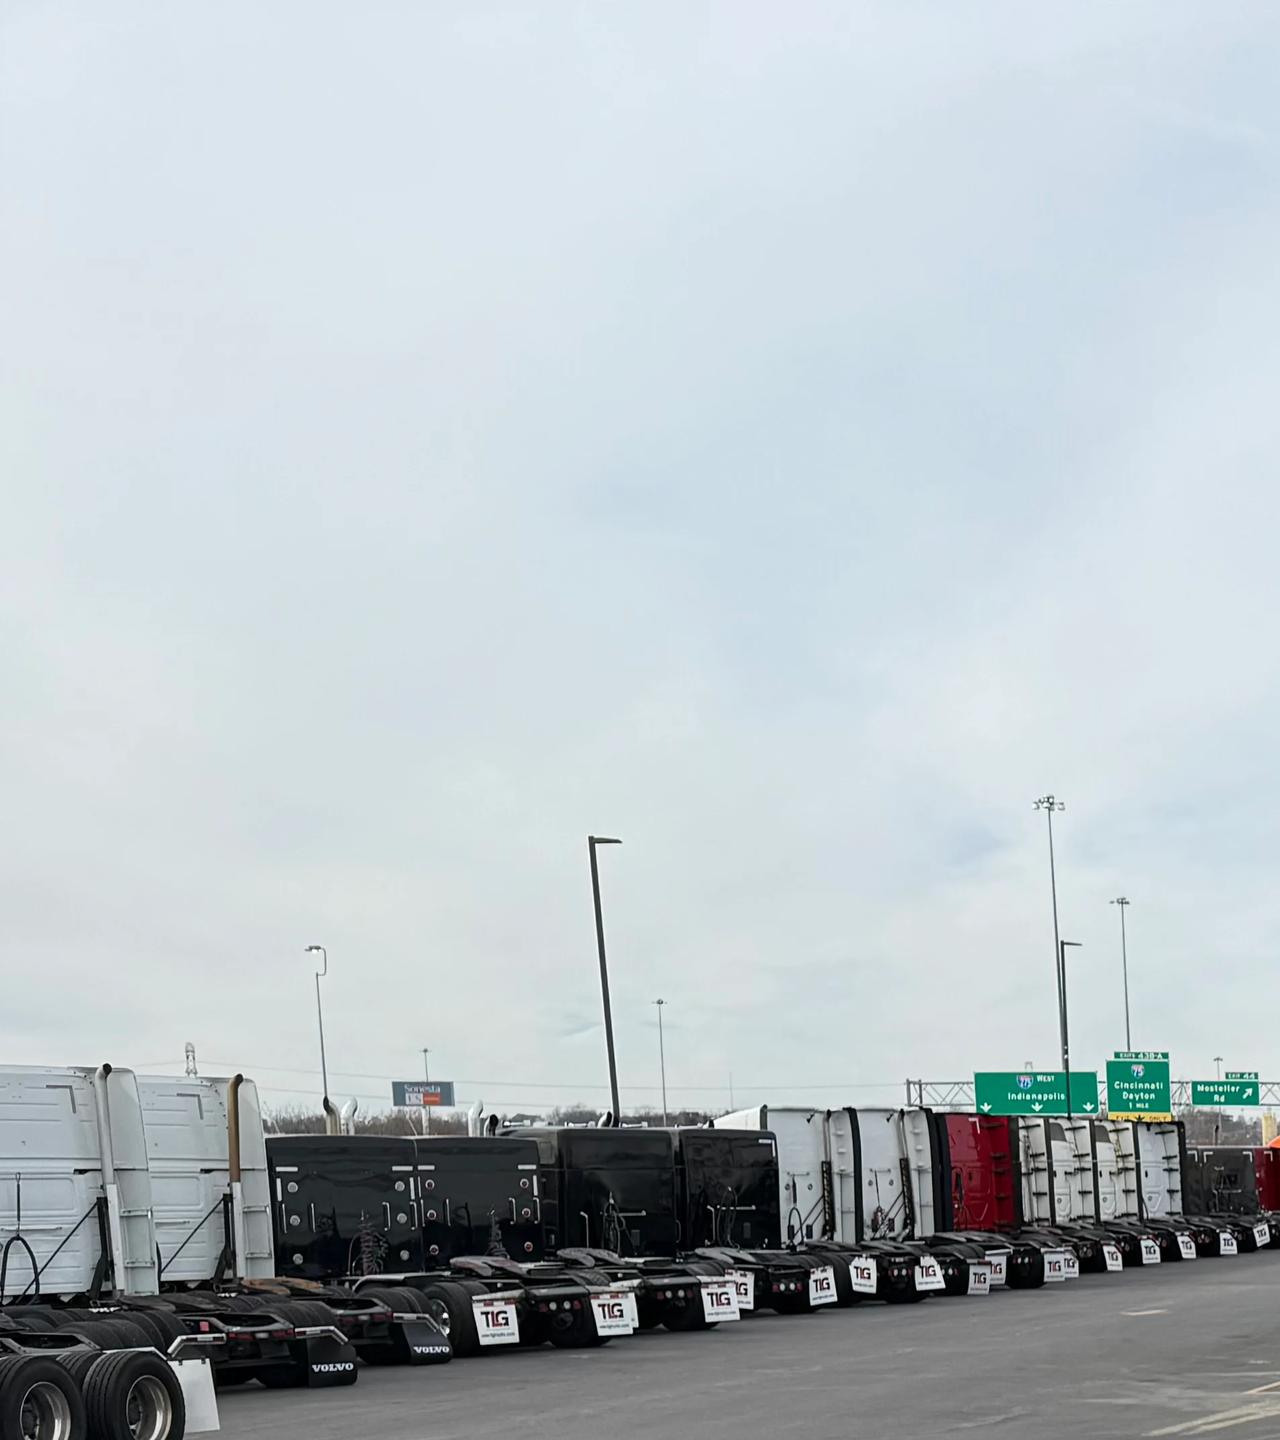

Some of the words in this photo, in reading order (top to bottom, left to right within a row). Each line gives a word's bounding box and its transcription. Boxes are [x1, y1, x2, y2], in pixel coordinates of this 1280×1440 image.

[404, 1084, 440, 1093] Sonesta
[1114, 1081, 1163, 1090] Cincinnati
[1197, 1084, 1240, 1093] Mosteller
[1008, 1092, 1065, 1101] Indianapolis
[1122, 1091, 1155, 1100] Dayton
[1214, 1094, 1225, 1102] Rd
[853, 1266, 871, 1280] TLG
[813, 1277, 830, 1293] TLG
[707, 1291, 731, 1307] TLG
[598, 1303, 624, 1320] TLG
[480, 1310, 510, 1328] TLG
[413, 1345, 450, 1354] VOLVO
[311, 1361, 354, 1372] VOLVO
